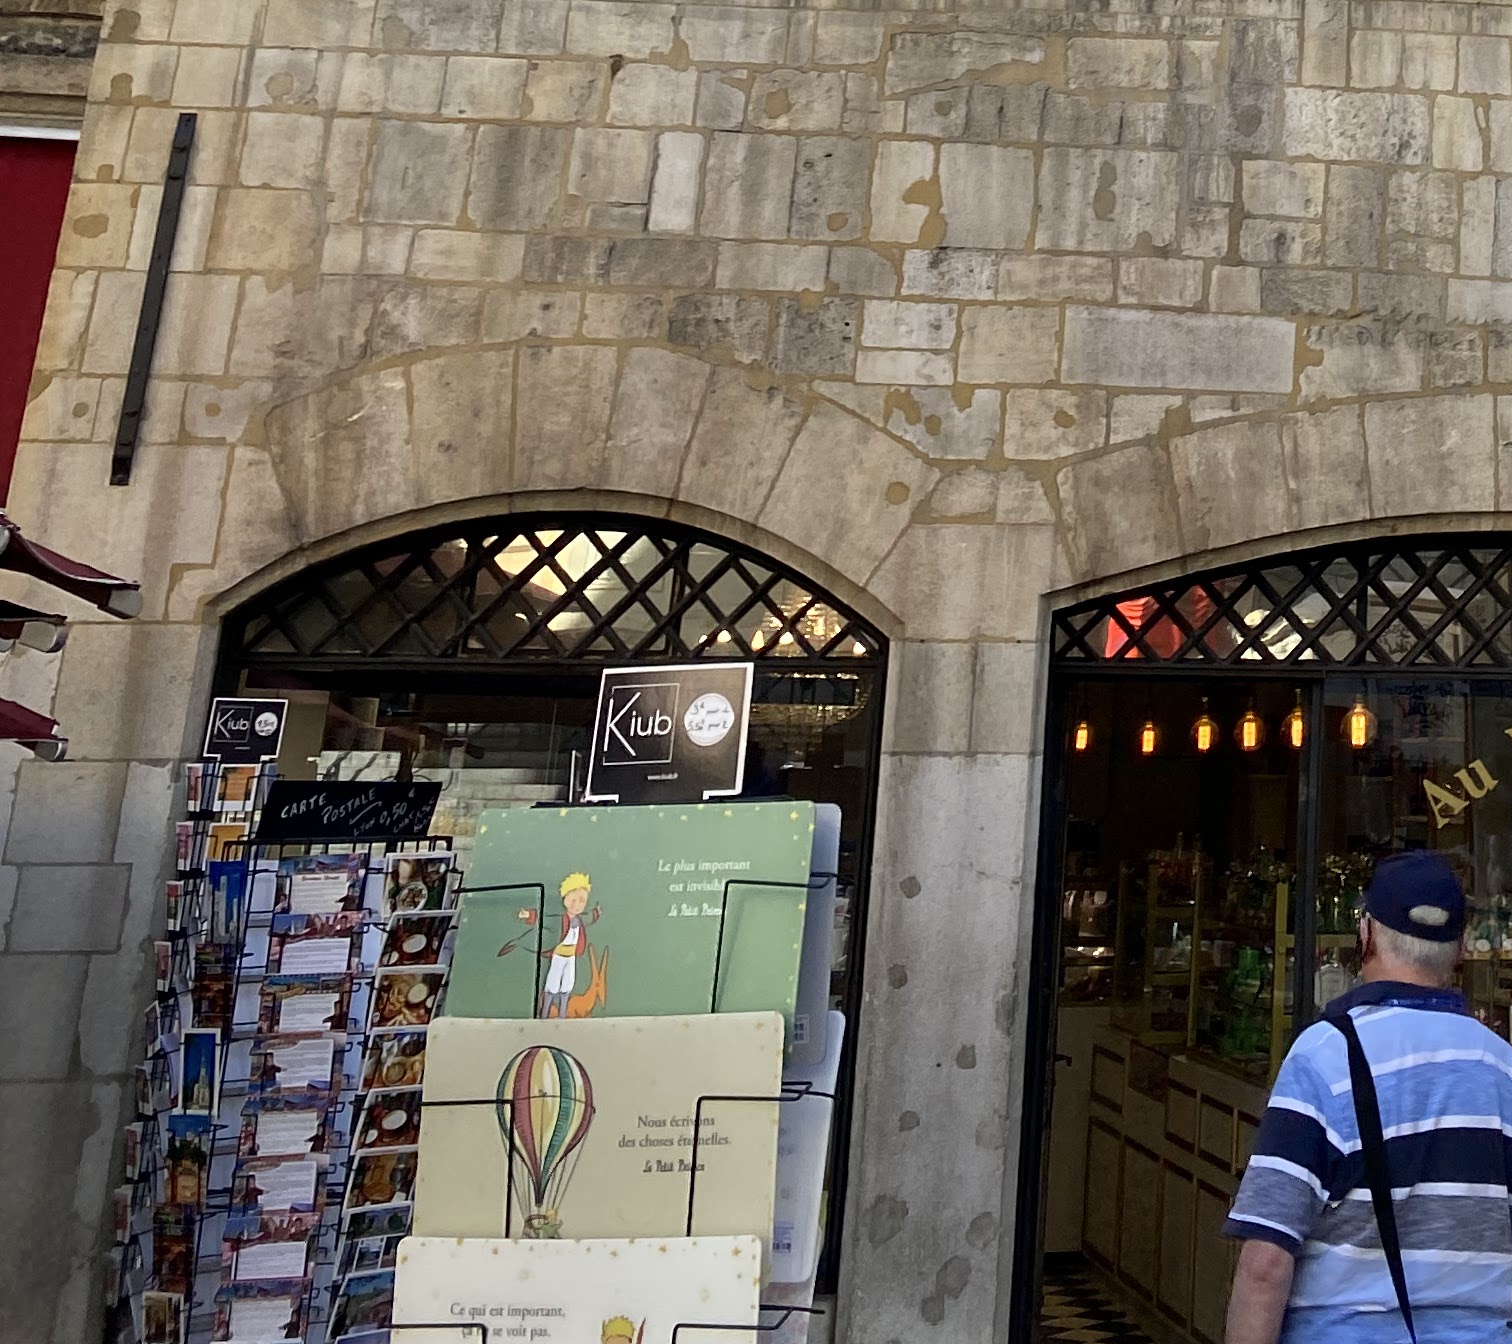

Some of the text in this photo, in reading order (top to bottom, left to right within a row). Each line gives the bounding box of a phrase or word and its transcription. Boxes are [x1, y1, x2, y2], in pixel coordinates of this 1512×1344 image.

[214, 709, 250, 739] Kiub
[603, 691, 672, 757] Kiub
[1421, 757, 1499, 829] Au
[280, 792, 327, 819] CARTE
[321, 787, 377, 825] POSTALE
[672, 858, 695, 875] plus
[697, 858, 751, 874] important
[637, 1114, 715, 1128] Nous écrions
[618, 1132, 732, 1149] des choses étenelles.
[450, 1302, 566, 1321] Ce qui est important,
[492, 1327, 503, 1338] se
[506, 1323, 527, 1338] voir
[529, 1327, 552, 1341] pas.
